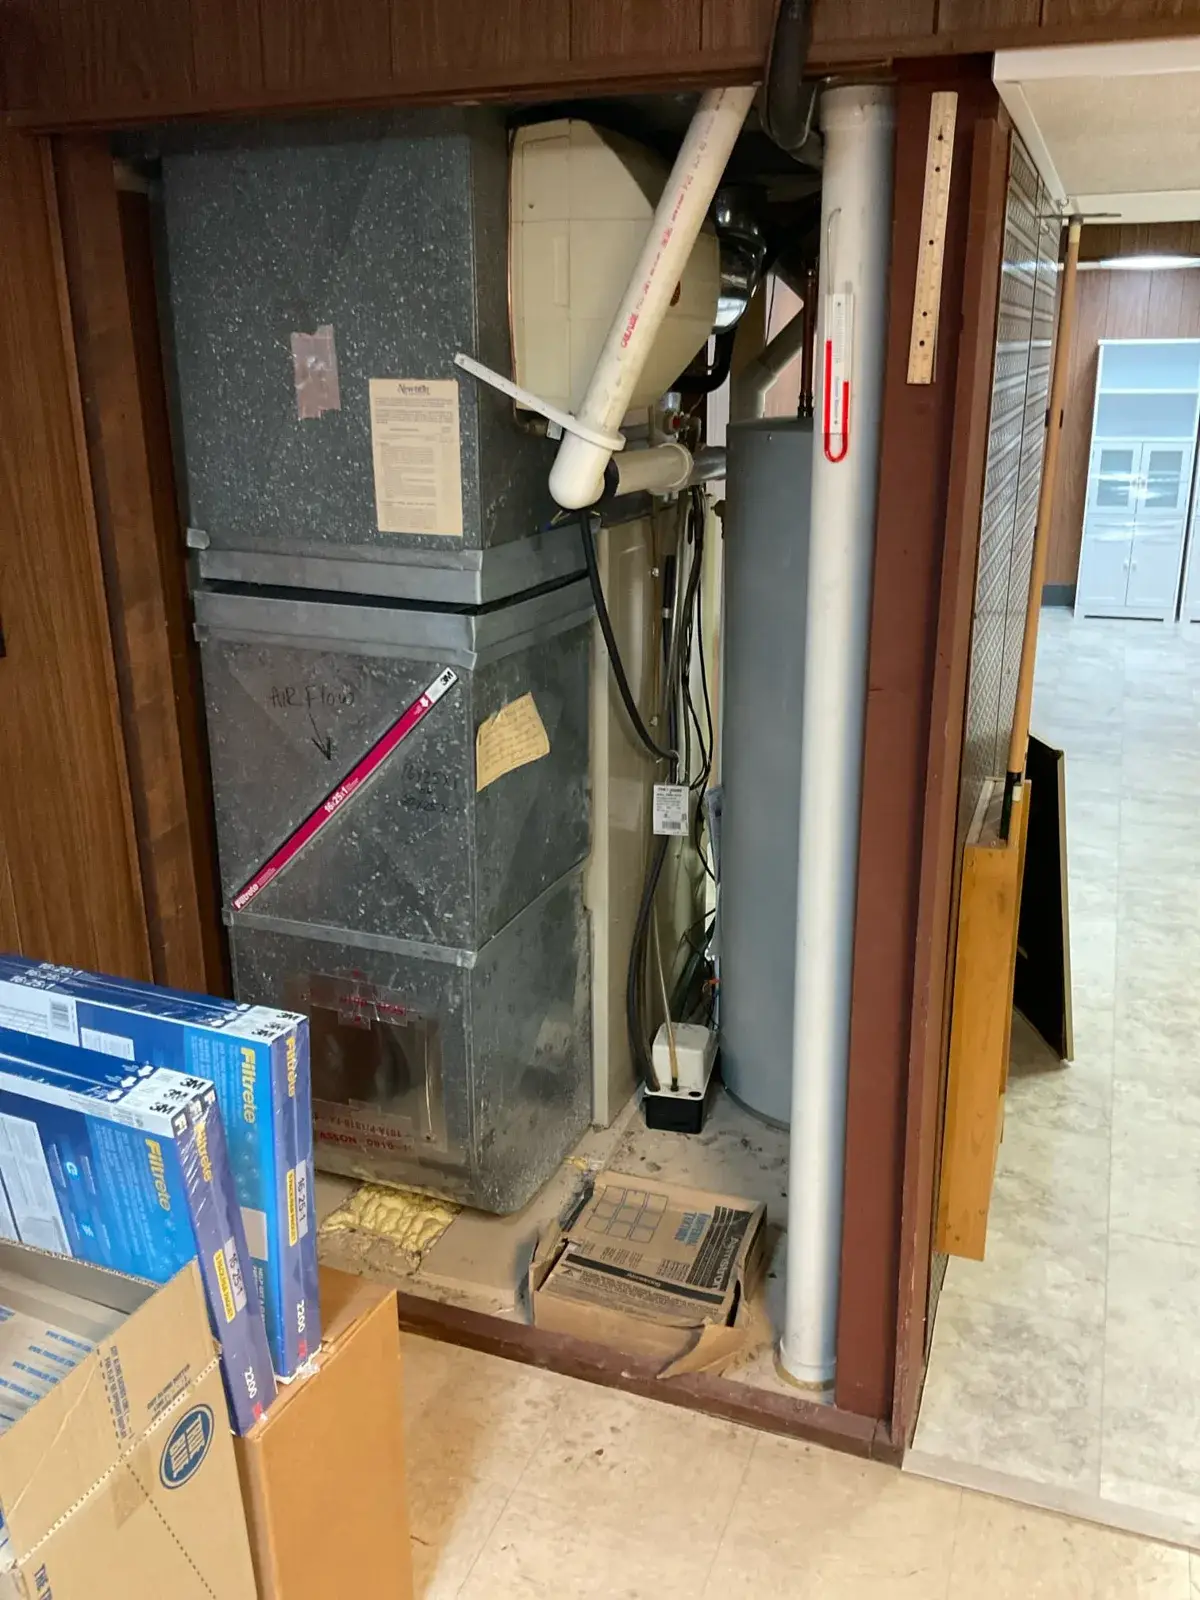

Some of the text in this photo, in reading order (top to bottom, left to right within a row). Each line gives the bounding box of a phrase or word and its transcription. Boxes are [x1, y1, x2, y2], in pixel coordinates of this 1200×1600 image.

[440, 670, 454, 686] 3M
[234, 883, 259, 909] Filtrete
[180, 1077, 206, 1090] 3M
[286, 1036, 297, 1098] Filtrete
[163, 1089, 188, 1102] 3M
[241, 1046, 257, 1124] Filtrete
[149, 1102, 176, 1115] 3M
[193, 1119, 213, 1183] Filtrete
[145, 1138, 171, 1212] Filtrete
[297, 1300, 306, 1333] 2200
[245, 1366, 257, 1399] 2200
